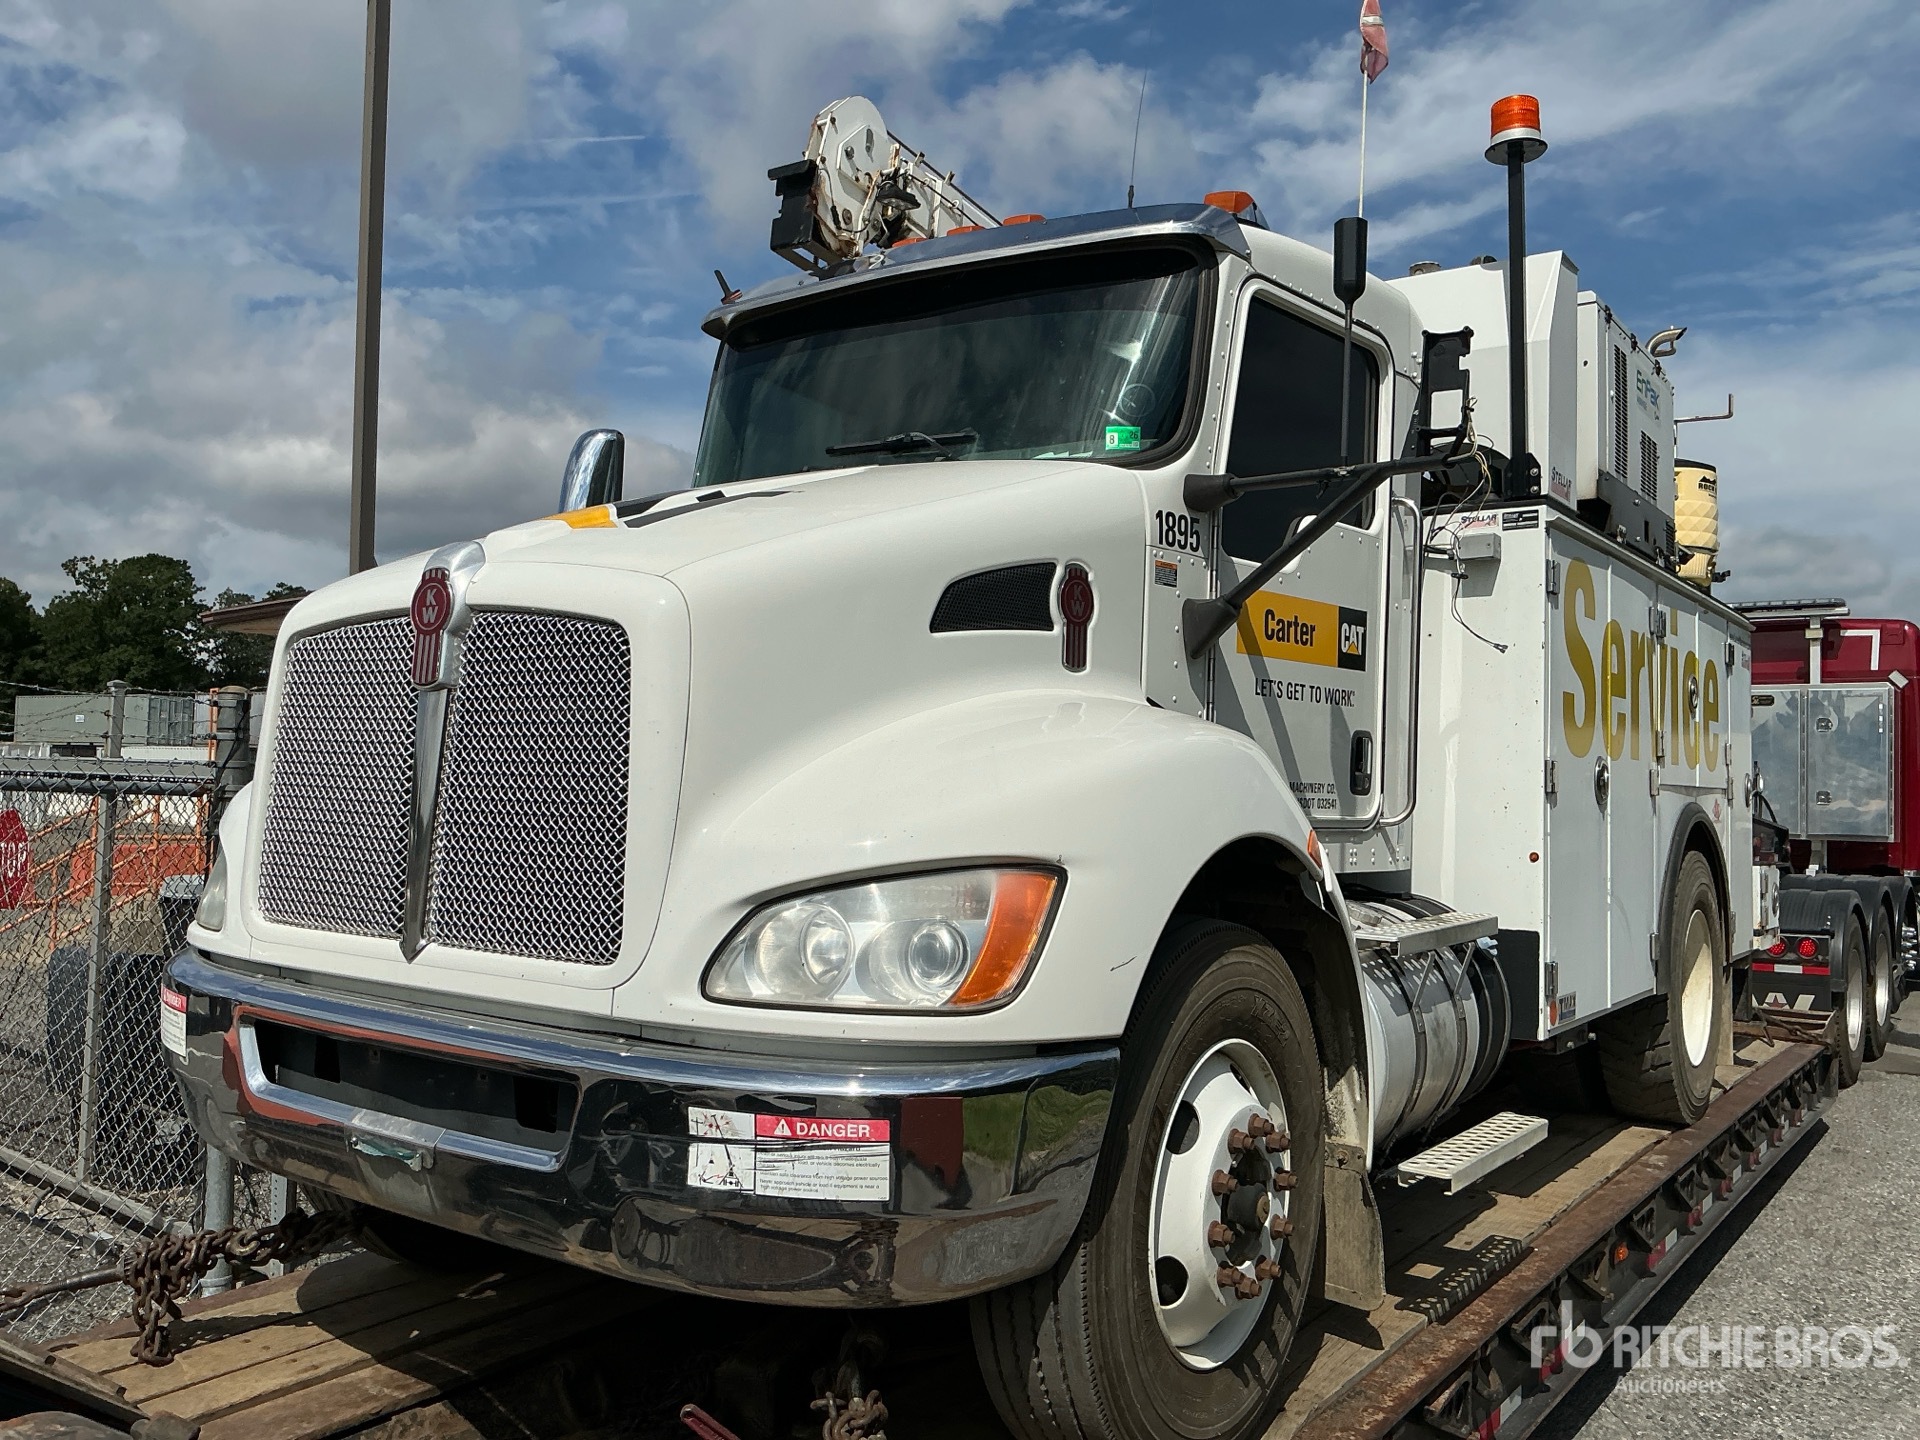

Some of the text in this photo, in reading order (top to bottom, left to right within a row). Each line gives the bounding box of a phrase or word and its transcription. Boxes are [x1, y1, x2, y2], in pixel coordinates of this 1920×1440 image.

[1155, 509, 1200, 552] 1895
[1264, 608, 1365, 656] Carter CAT
[1562, 556, 1719, 773] Service
[1255, 677, 1283, 699] LET'S
[1286, 681, 1306, 701] GET
[1309, 685, 1322, 704] TO
[1289, 781, 1325, 793] MACHINERY
[1297, 797, 1315, 809] SDOT
[796, 1121, 870, 1138] DANGER
